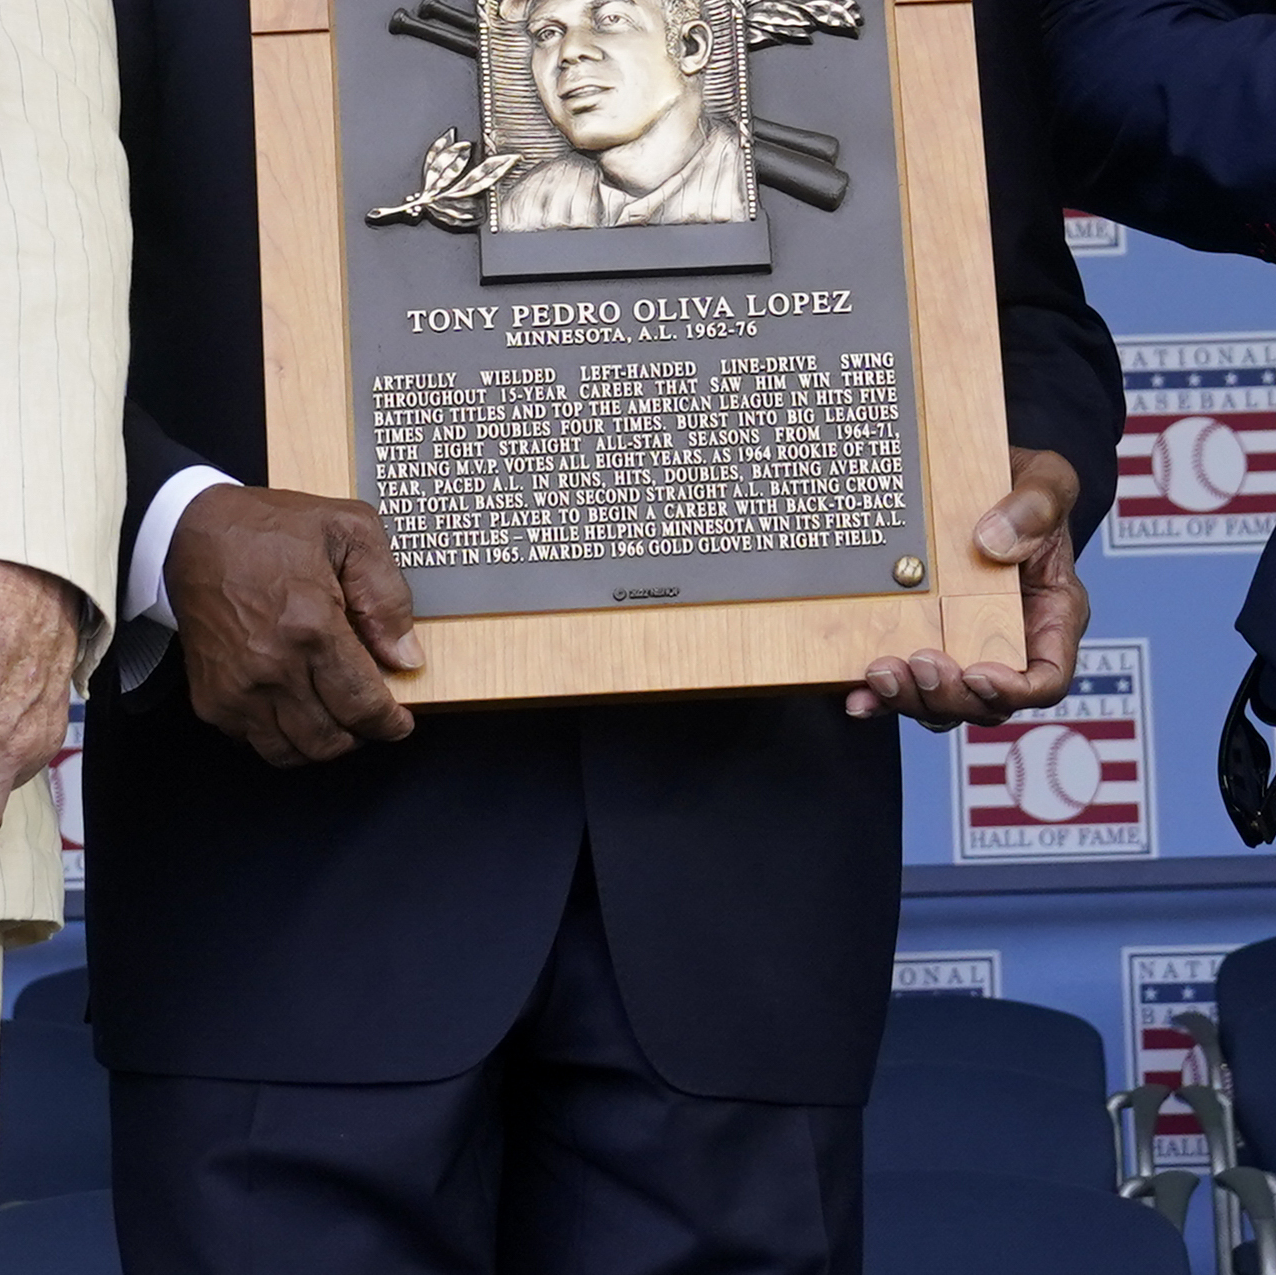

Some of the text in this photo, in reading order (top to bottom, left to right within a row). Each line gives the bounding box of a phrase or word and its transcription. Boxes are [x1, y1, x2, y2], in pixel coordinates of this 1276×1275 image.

[407, 289, 852, 332] TONY PEDRO OLIVA LOPEZ
[505, 320, 757, 349] MINNESOTA, A.L. 1962-76
[372, 351, 894, 391] ARTFULLY WIELDED LEFT-HANDED LINE-DRIVE SWING
[372, 369, 896, 409] THROUGHOUT 15-YEAR CAREER THAT SAW HIM WIN THREE
[373, 386, 897, 426] BATTING TITLES AND TOP THE AMERICAN LEAGUE IN HITS FIVE
[375, 421, 899, 461] WITH EIGHT STRAIGHT ALL-STAR SEASONS FROM 1964-71,
[1119, 515, 1273, 539] HALL OF FAM
[970, 825, 1141, 849] HALL OF FAME
